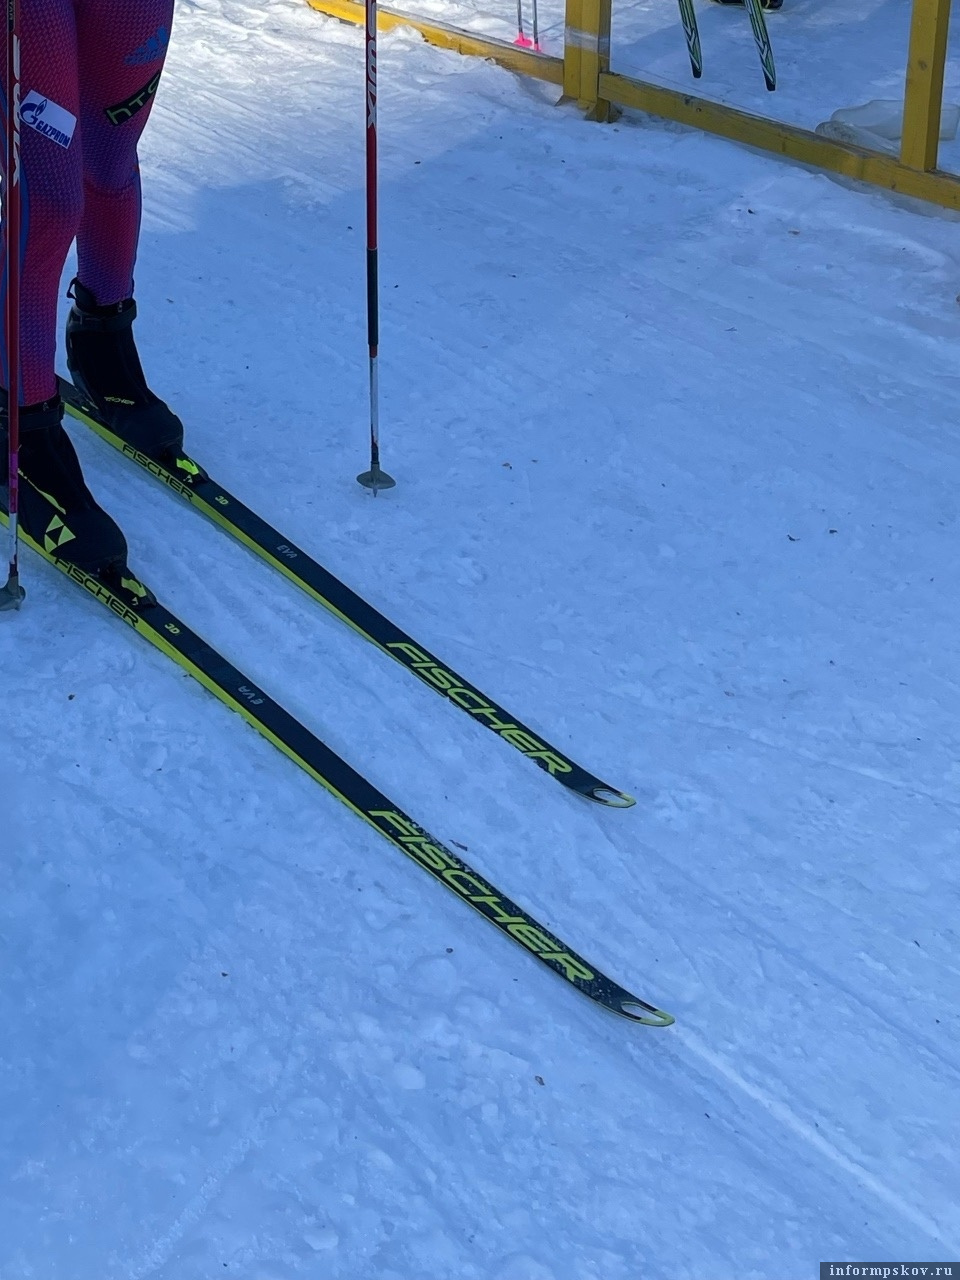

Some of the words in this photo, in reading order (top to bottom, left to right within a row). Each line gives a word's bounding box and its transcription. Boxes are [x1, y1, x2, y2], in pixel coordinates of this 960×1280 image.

[35, 120, 71, 148] GAZPROM
[122, 444, 194, 501] FISCHER
[54, 557, 139, 628] FISCHER
[387, 641, 572, 775] FISCHER
[368, 809, 594, 983] FISCHER
